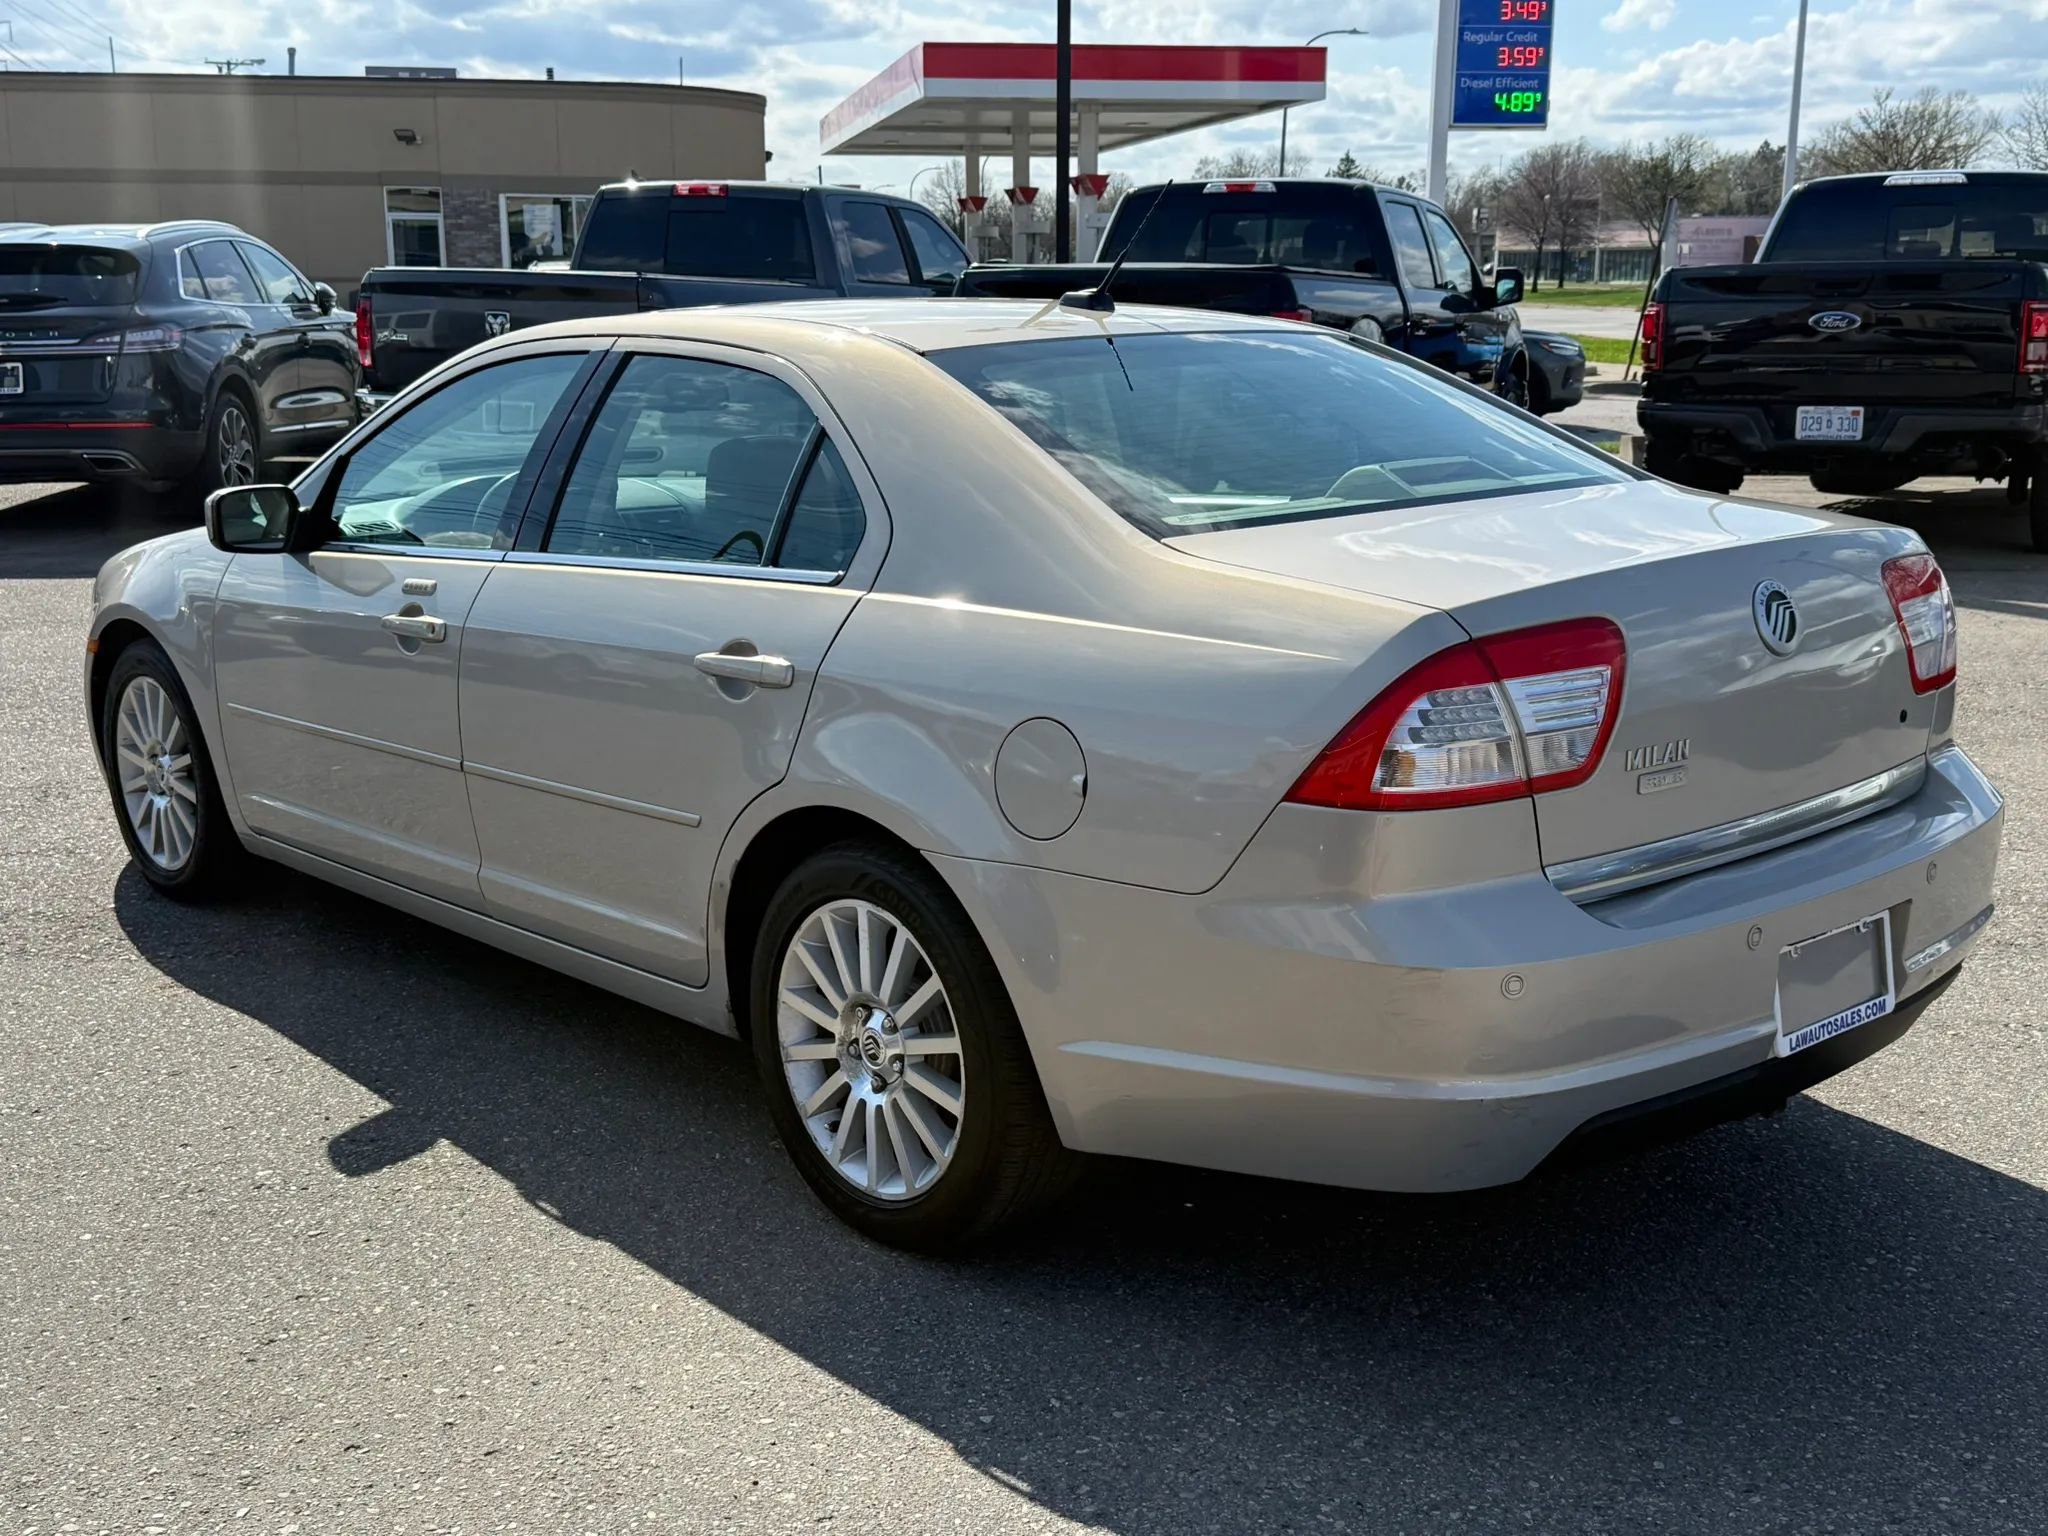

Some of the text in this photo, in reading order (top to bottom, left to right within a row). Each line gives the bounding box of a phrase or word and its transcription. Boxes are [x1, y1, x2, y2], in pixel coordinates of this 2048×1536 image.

[1463, 31, 1538, 44] Regular Credit
[1460, 77, 1539, 88] Diesel Efficient
[1819, 315, 1849, 328] Ford
[1801, 416, 1823, 432] 029
[1836, 416, 1859, 433] 330
[1625, 739, 1690, 771] MILAN
[1789, 998, 1887, 1052] LAWAUTOSALES.COM
